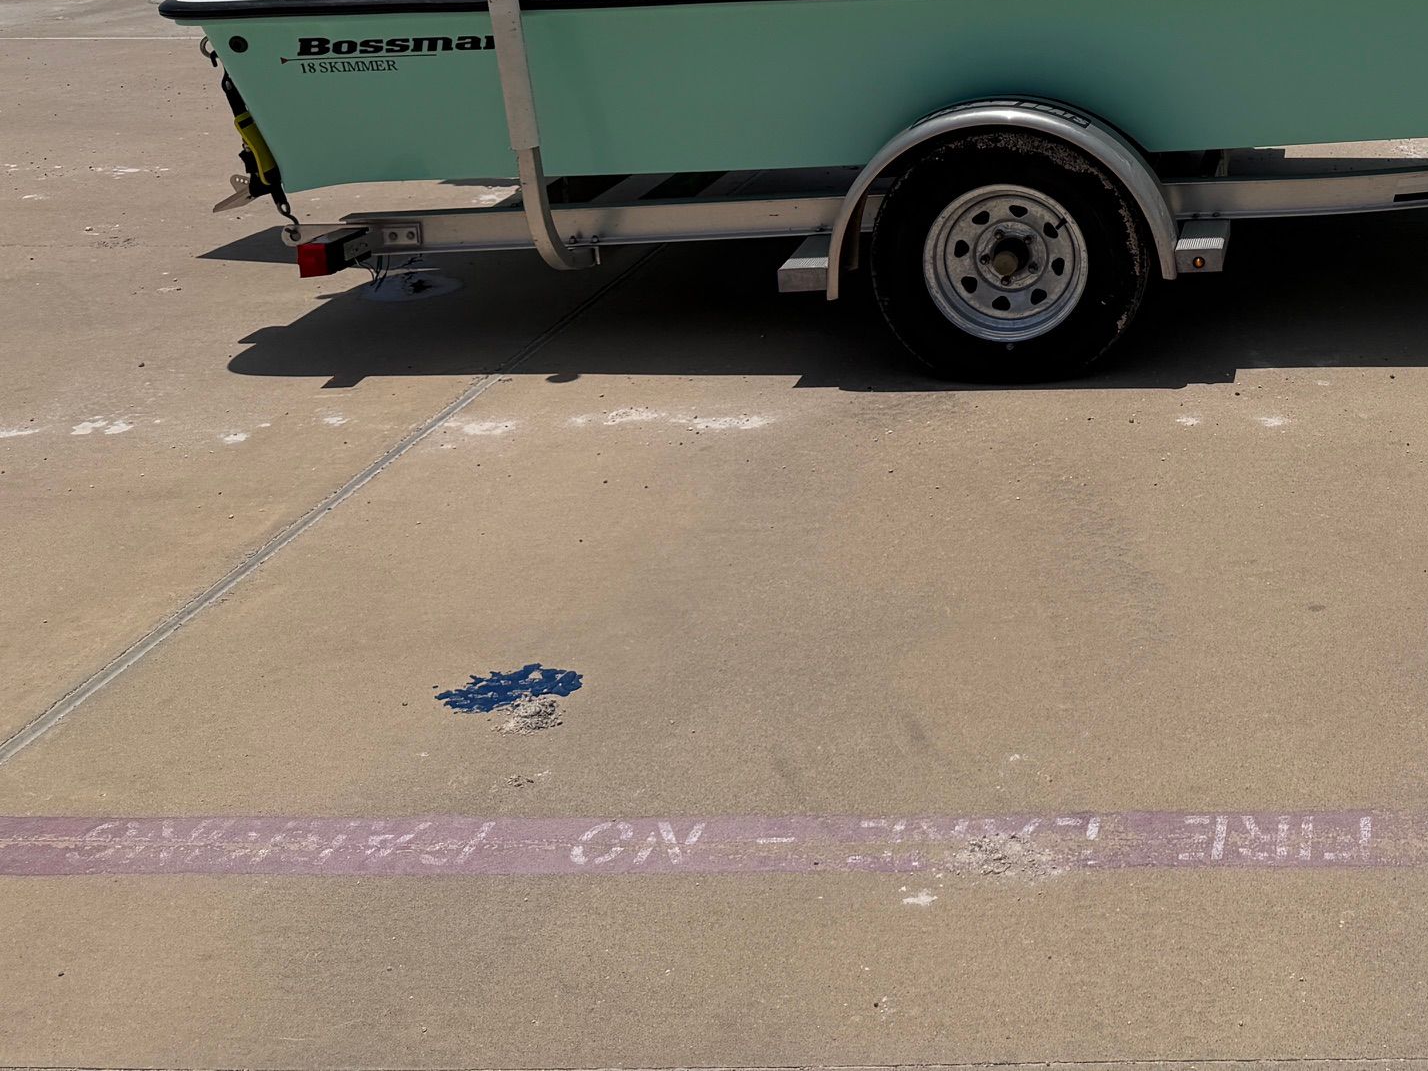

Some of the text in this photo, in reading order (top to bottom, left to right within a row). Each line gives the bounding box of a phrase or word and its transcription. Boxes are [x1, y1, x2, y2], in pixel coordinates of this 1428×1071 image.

[300, 59, 399, 74] 18 SKIMMER
[570, 820, 706, 866] NO
